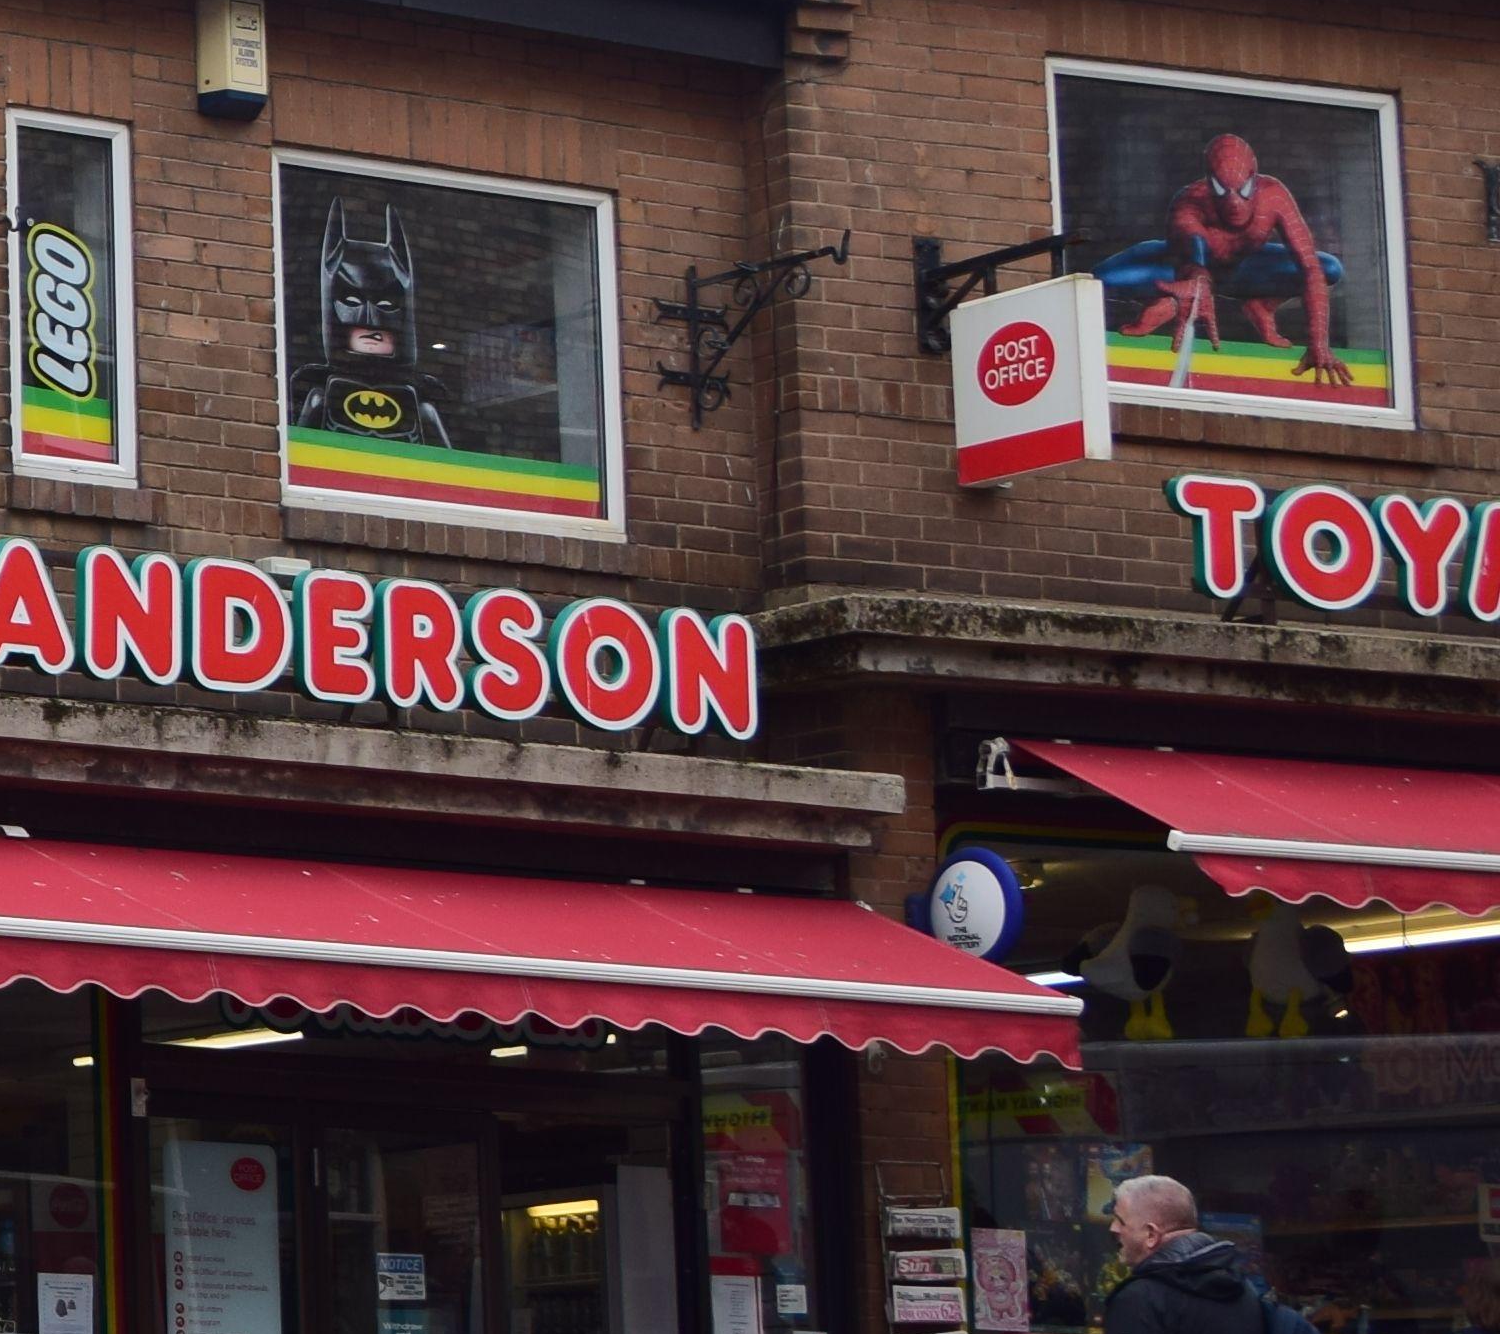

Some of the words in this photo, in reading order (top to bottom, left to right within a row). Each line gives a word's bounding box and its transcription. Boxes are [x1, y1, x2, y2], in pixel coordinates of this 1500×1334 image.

[31, 227, 94, 400] LEGO
[994, 335, 1041, 365] POST
[985, 357, 1047, 390] OFFICE
[380, 1258, 421, 1272] NOTICE
[898, 1256, 932, 1274] Sun
